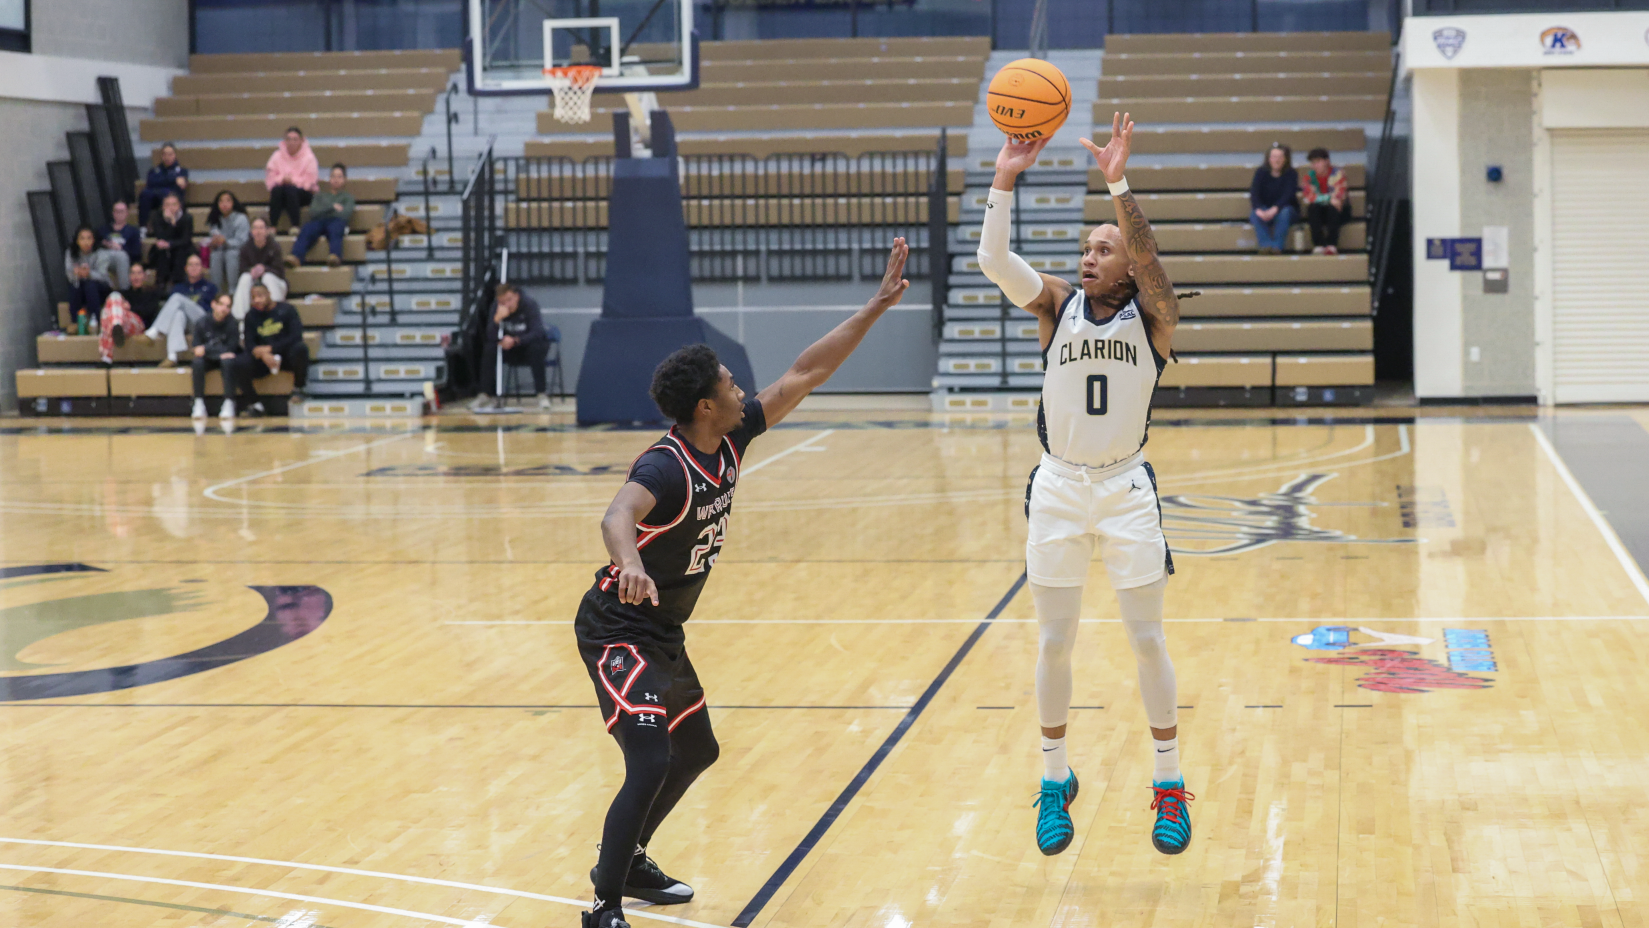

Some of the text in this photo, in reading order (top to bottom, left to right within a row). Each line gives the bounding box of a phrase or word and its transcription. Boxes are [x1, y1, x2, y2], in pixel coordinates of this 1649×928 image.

[1551, 32, 1568, 48] K
[995, 105, 1026, 119] EVO
[1060, 339, 1137, 366] CLARION
[1086, 374, 1108, 416] 0
[684, 512, 731, 575] 23
